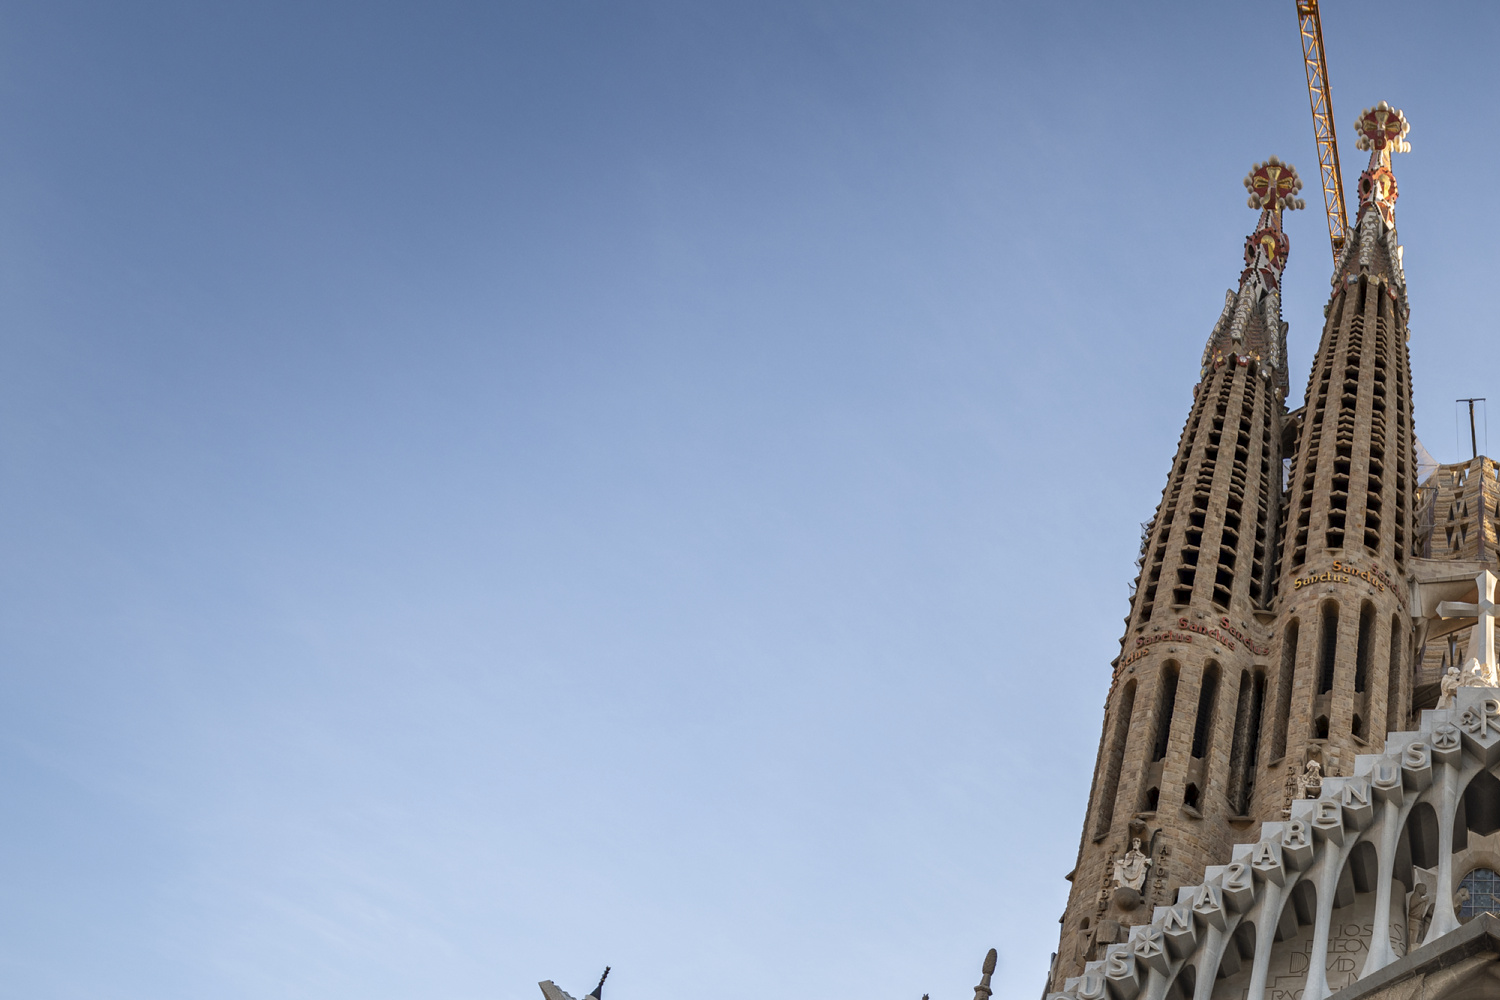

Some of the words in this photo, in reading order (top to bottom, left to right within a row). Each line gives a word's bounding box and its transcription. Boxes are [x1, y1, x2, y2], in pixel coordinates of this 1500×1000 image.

[1294, 571, 1349, 590] Sanctus
[1332, 560, 1385, 592] Sanctus
[1136, 630, 1193, 648] Sanctus
[1178, 617, 1236, 651] Sanctus
[1219, 616, 1269, 655] Sanctus
